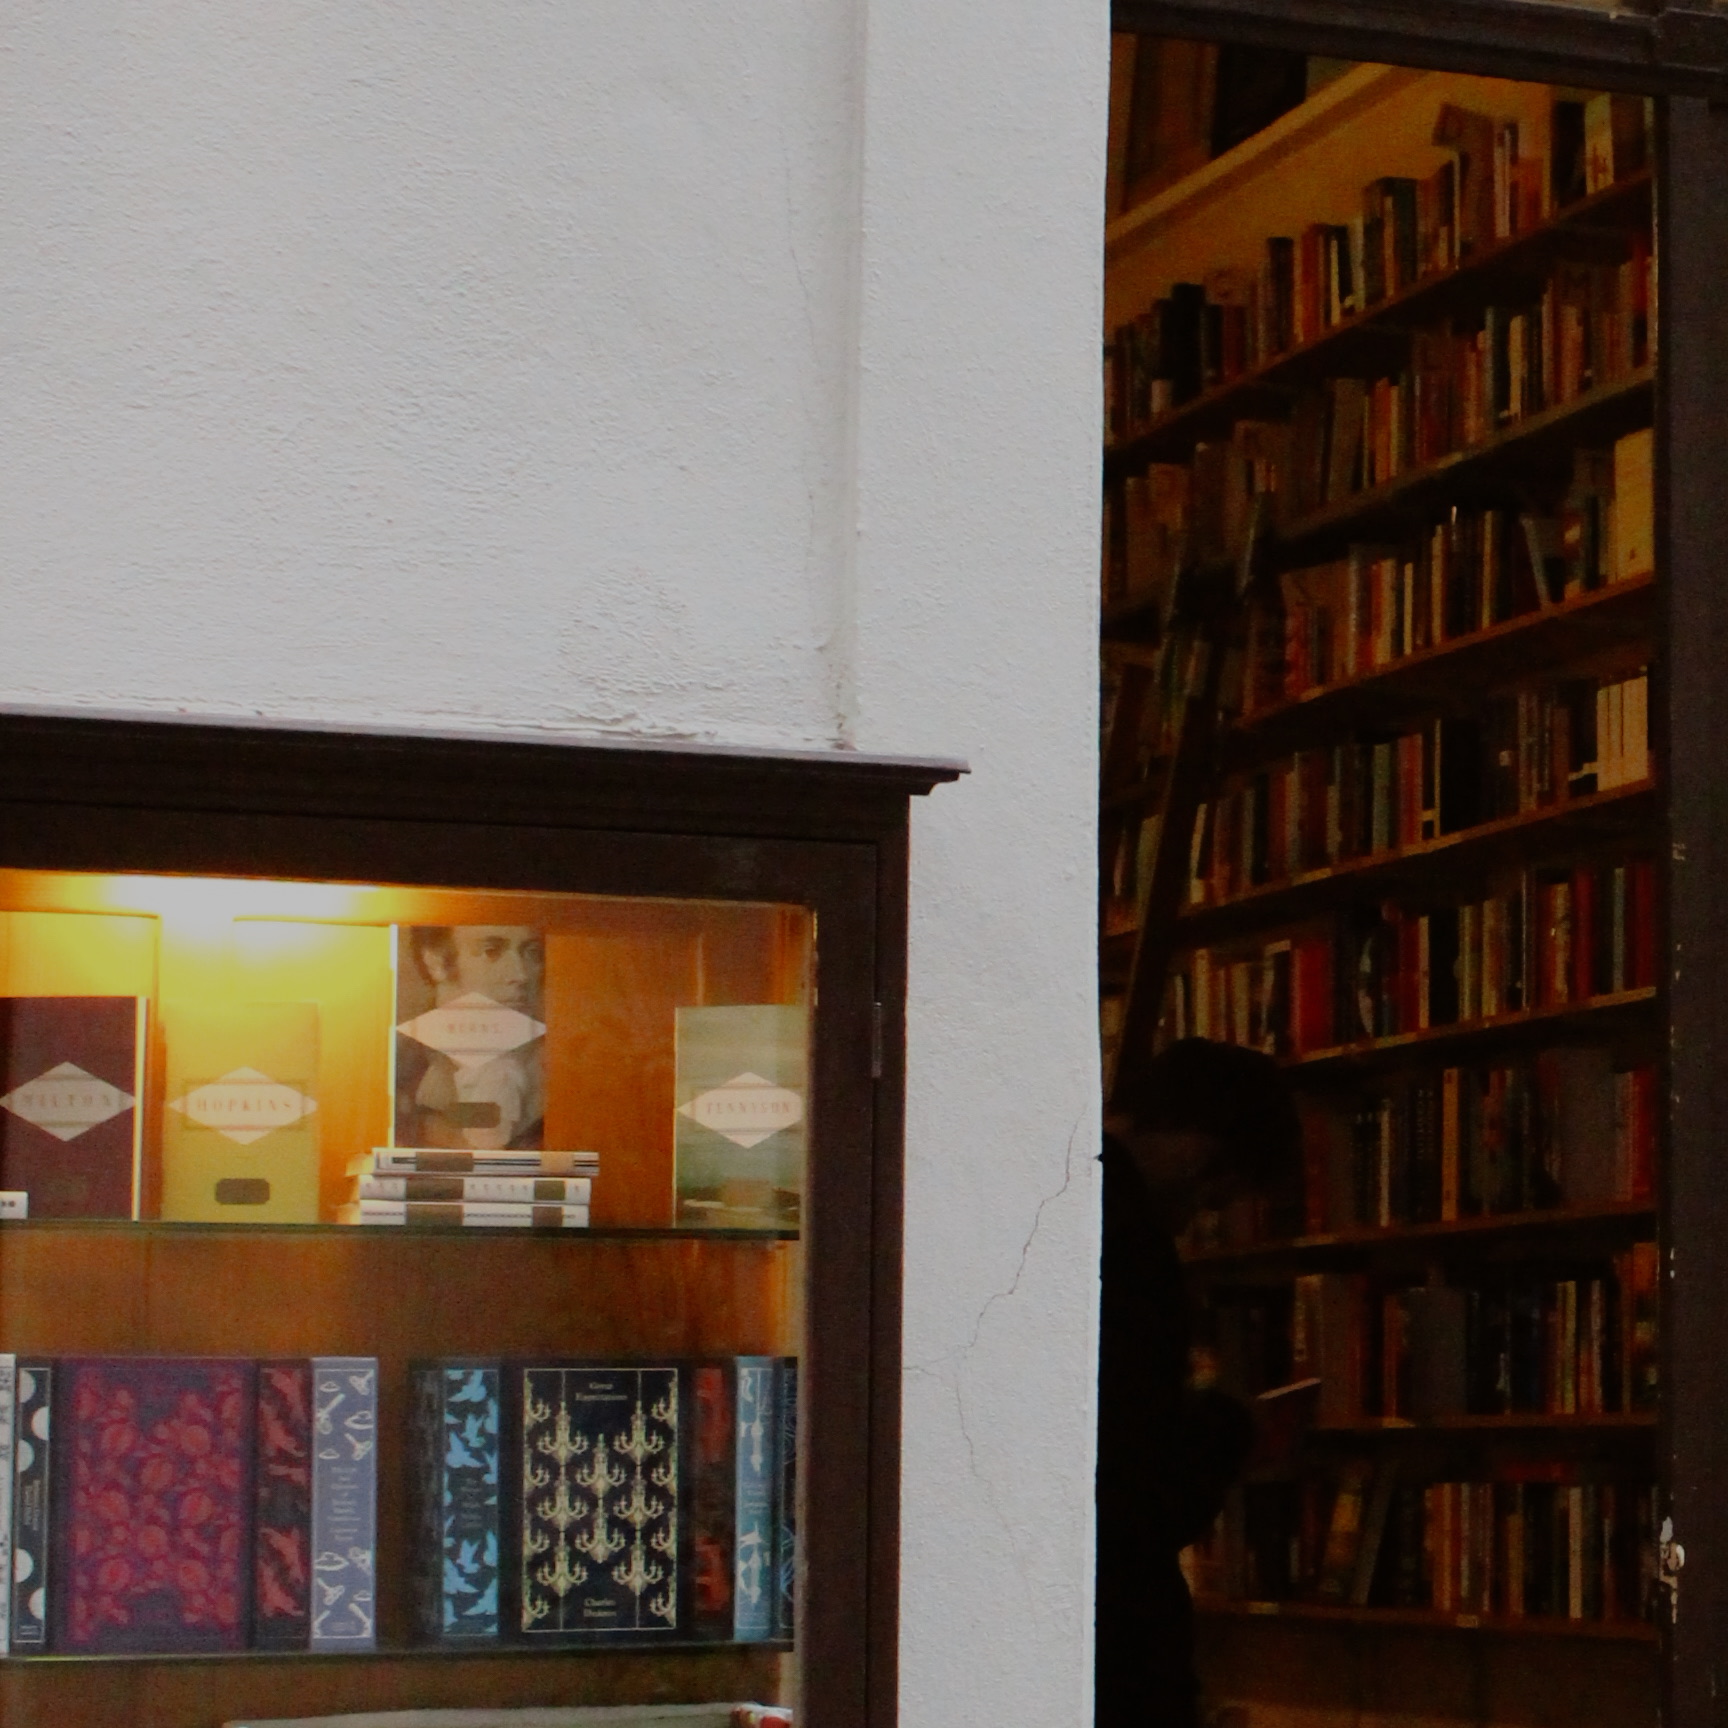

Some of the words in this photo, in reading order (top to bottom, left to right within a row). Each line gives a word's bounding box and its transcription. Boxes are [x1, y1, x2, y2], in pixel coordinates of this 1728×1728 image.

[23, 1092, 112, 1109] MILTON
[195, 1096, 293, 1113] HOPKINS
[705, 1101, 792, 1116] TENNYSON
